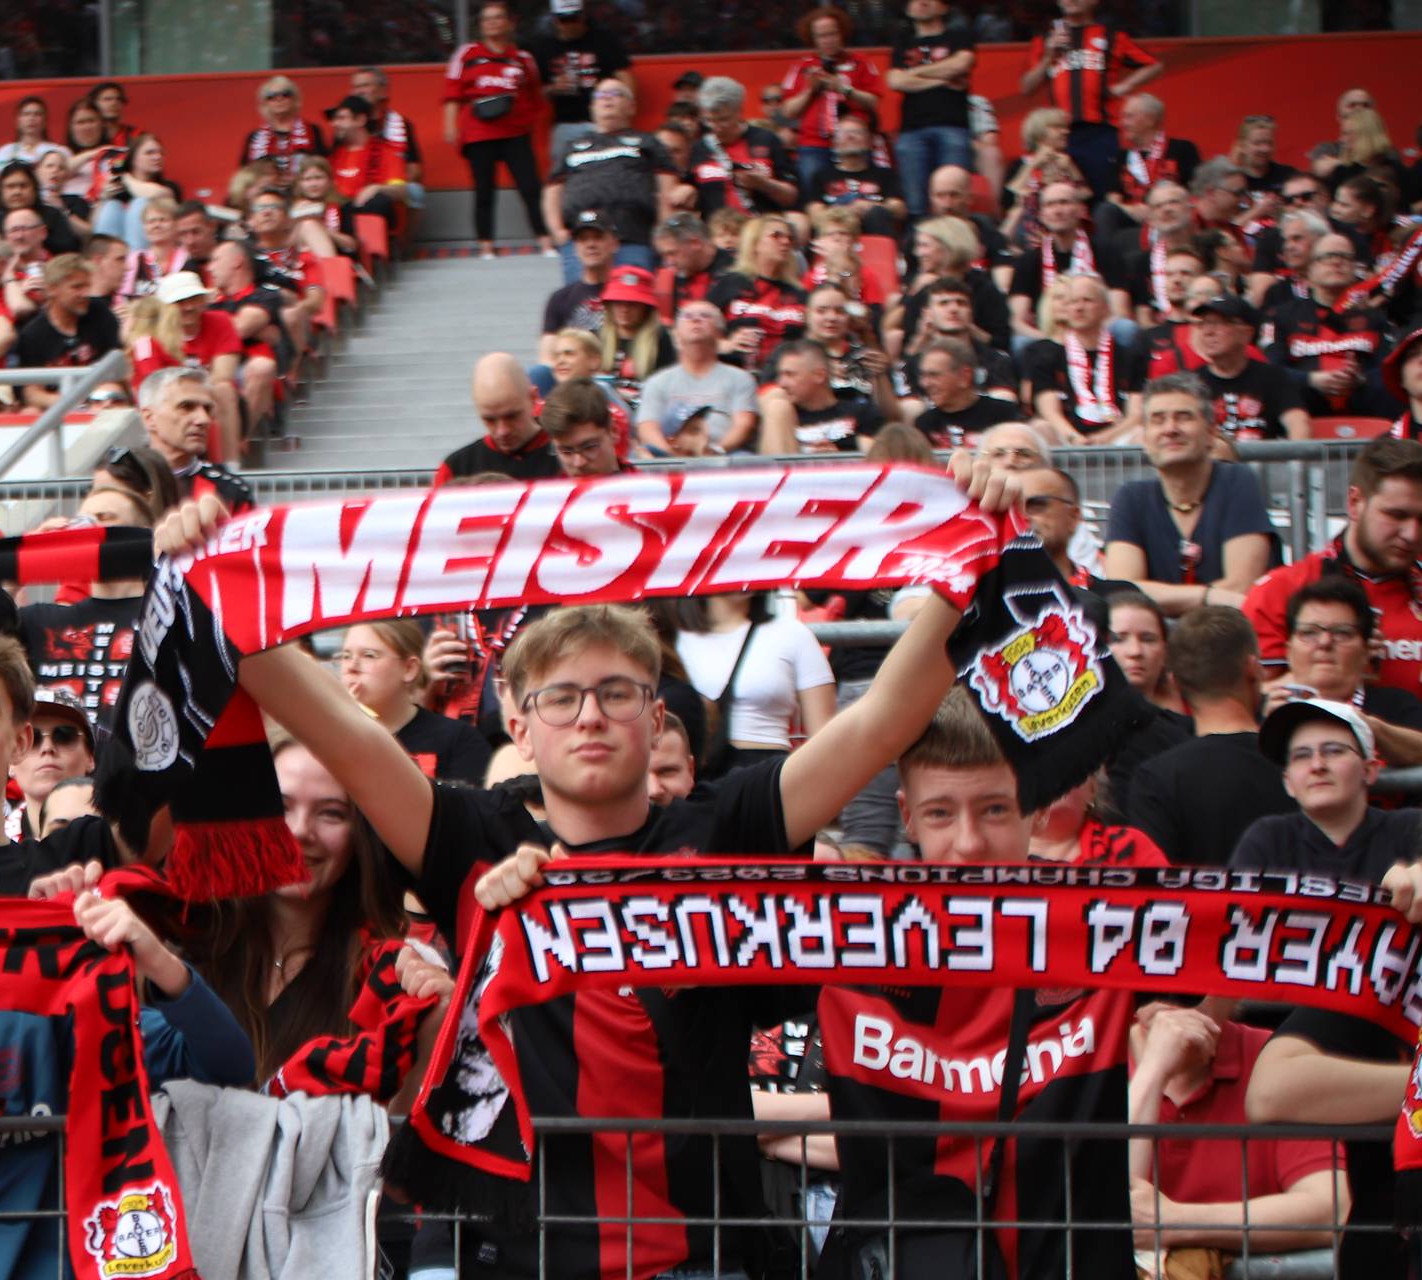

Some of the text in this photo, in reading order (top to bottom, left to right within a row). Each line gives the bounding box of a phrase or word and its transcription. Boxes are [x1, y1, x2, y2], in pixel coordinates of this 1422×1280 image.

[280, 468, 971, 632] MEISTER
[38, 663, 127, 678] MEIST
[823, 864, 1138, 887] CHAMPIONS
[520, 895, 1049, 983] LEVERKUSEN
[1086, 899, 1190, 975] 04
